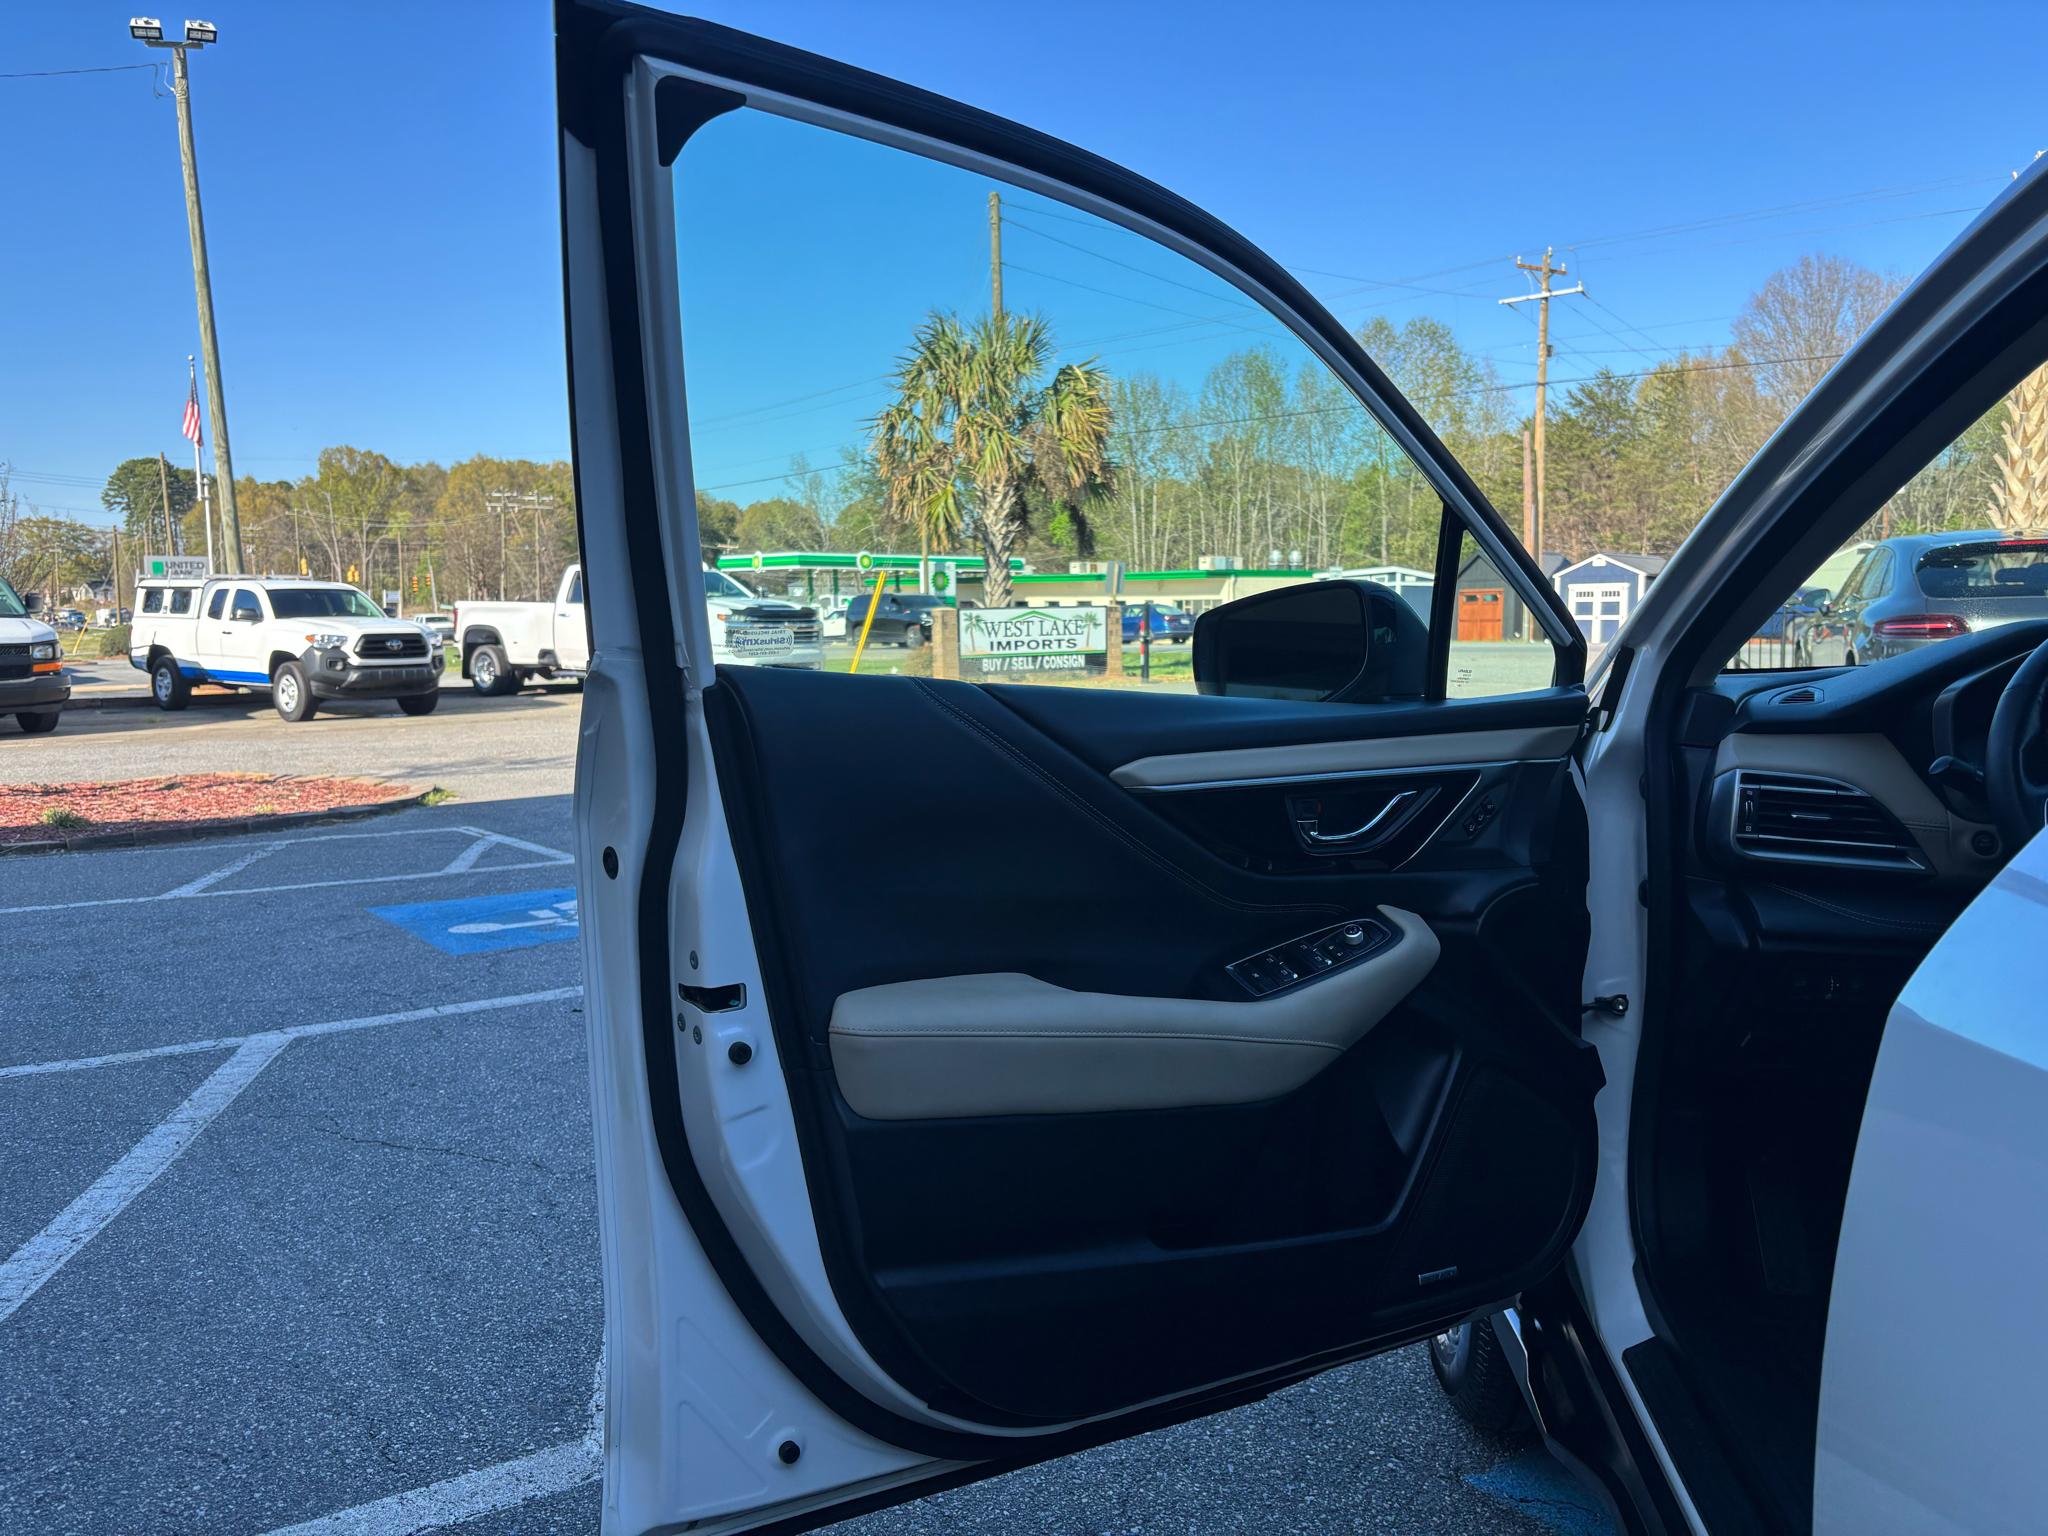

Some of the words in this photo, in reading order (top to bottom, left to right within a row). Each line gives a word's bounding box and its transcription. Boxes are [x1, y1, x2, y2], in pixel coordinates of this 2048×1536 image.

[165, 561, 205, 570] UNITED
[984, 621, 1035, 638] WEST
[1039, 619, 1084, 637] LAKE
[990, 638, 1077, 652] IMPORTS
[982, 658, 1002, 672] BUY
[1011, 656, 1035, 670] SELL
[1043, 654, 1086, 669] CONSIGN
